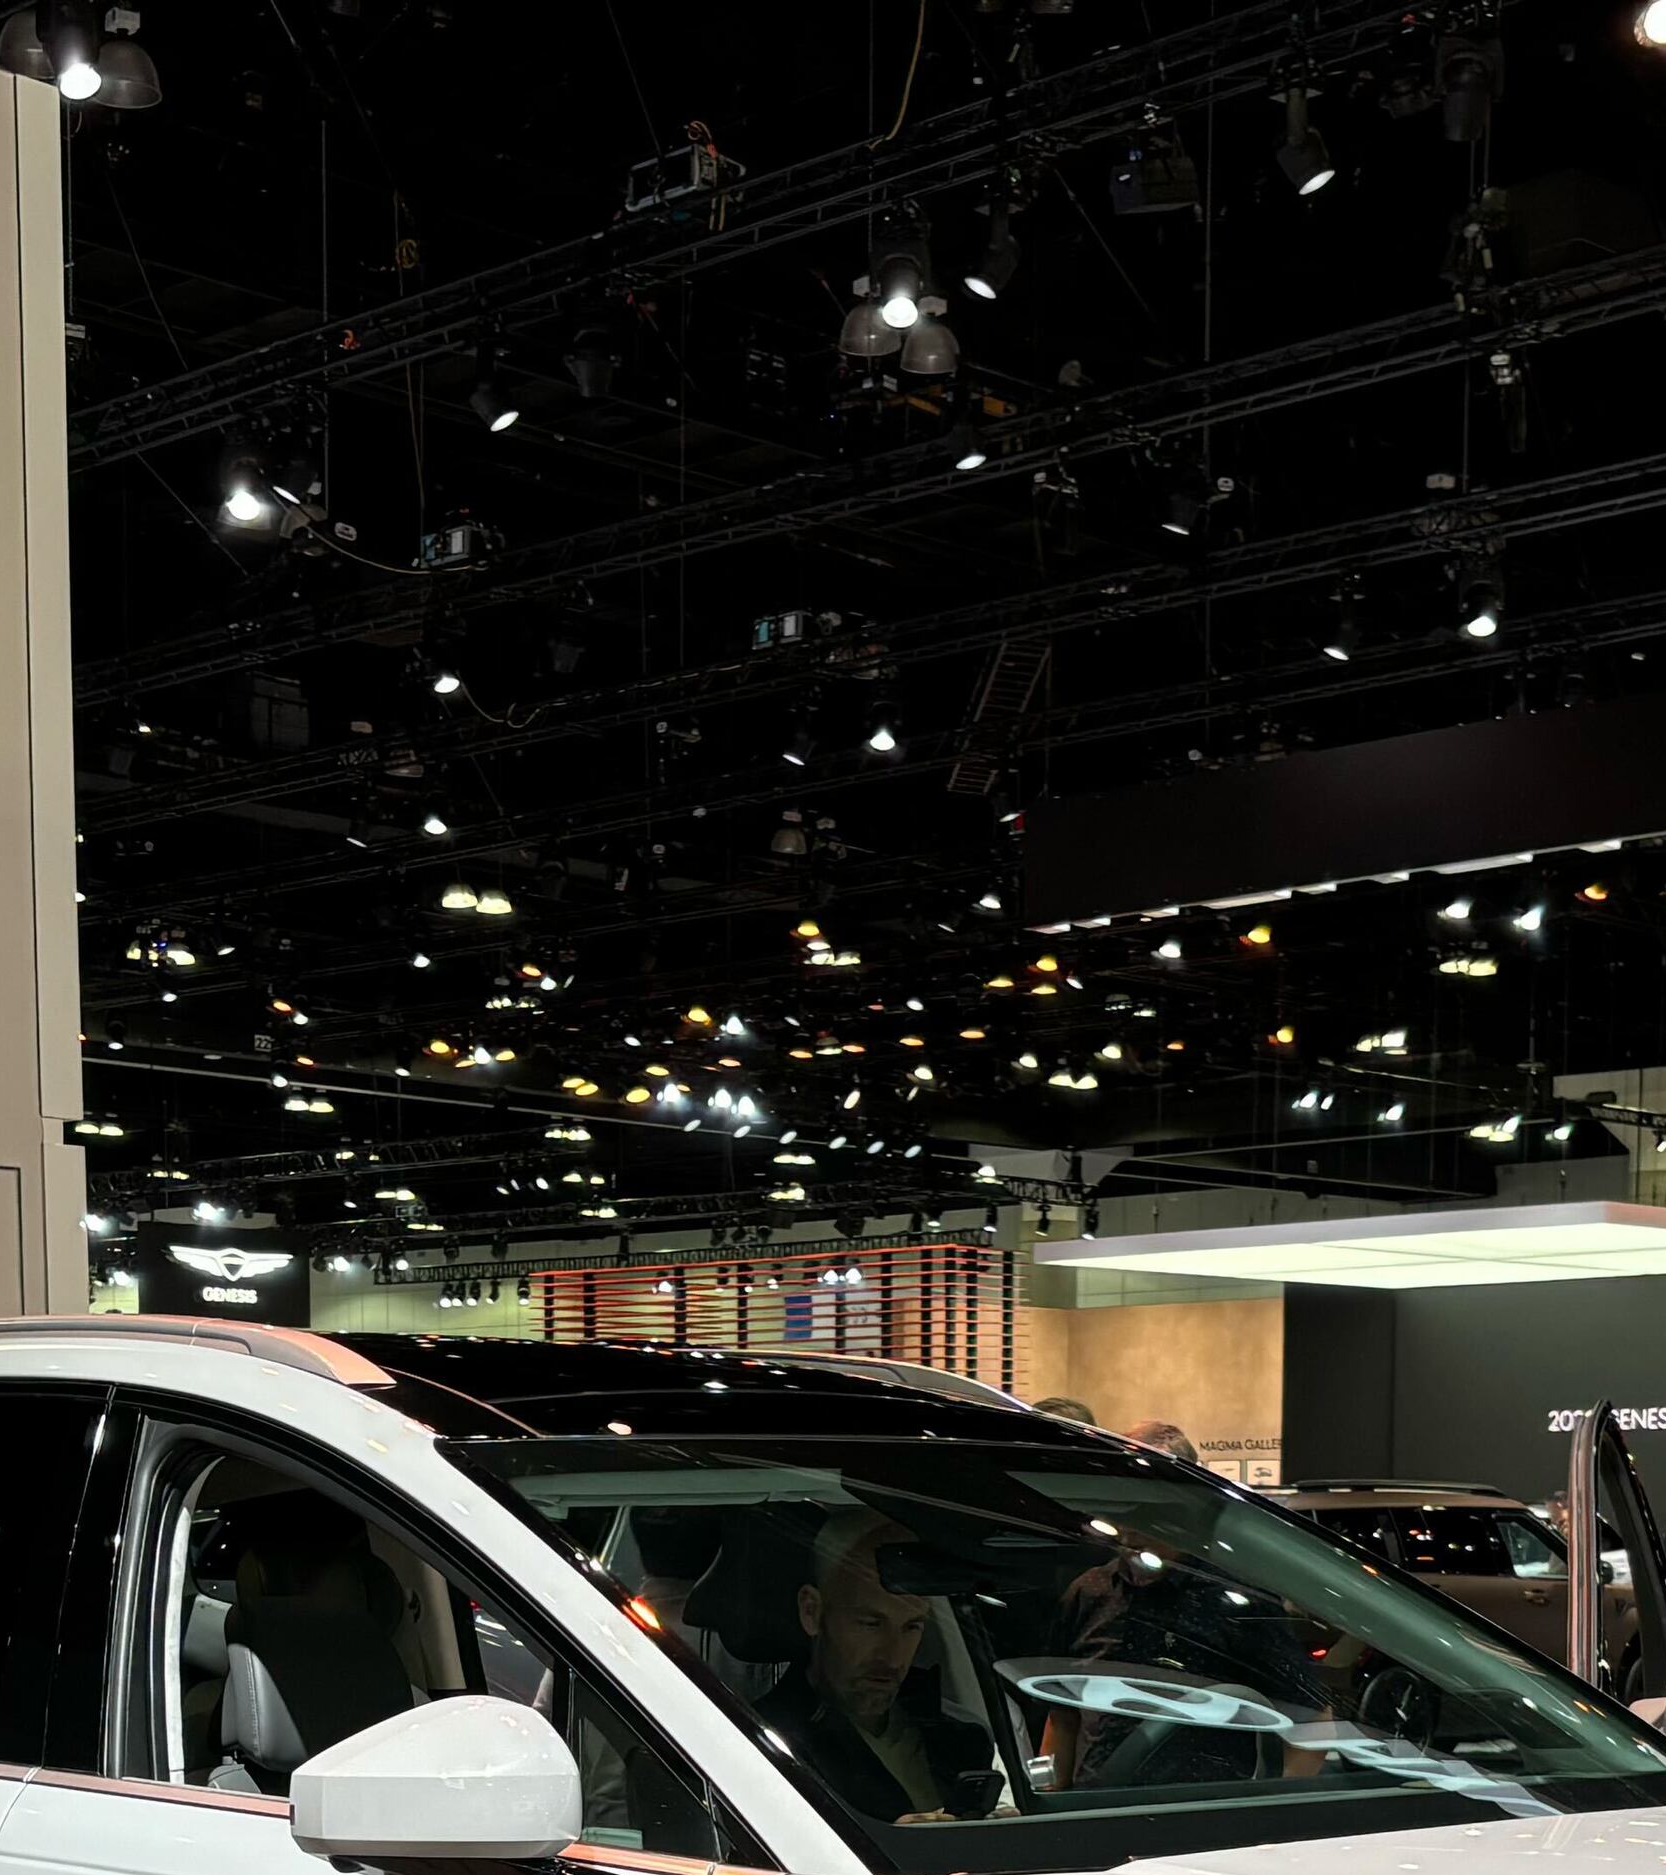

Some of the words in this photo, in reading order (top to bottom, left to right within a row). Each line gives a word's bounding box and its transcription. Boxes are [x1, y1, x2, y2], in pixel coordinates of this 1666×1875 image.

[202, 1287, 258, 1304] GENESIS
[1547, 1409, 1593, 1432] 20
[1200, 1440, 1243, 1452] MAGMA
